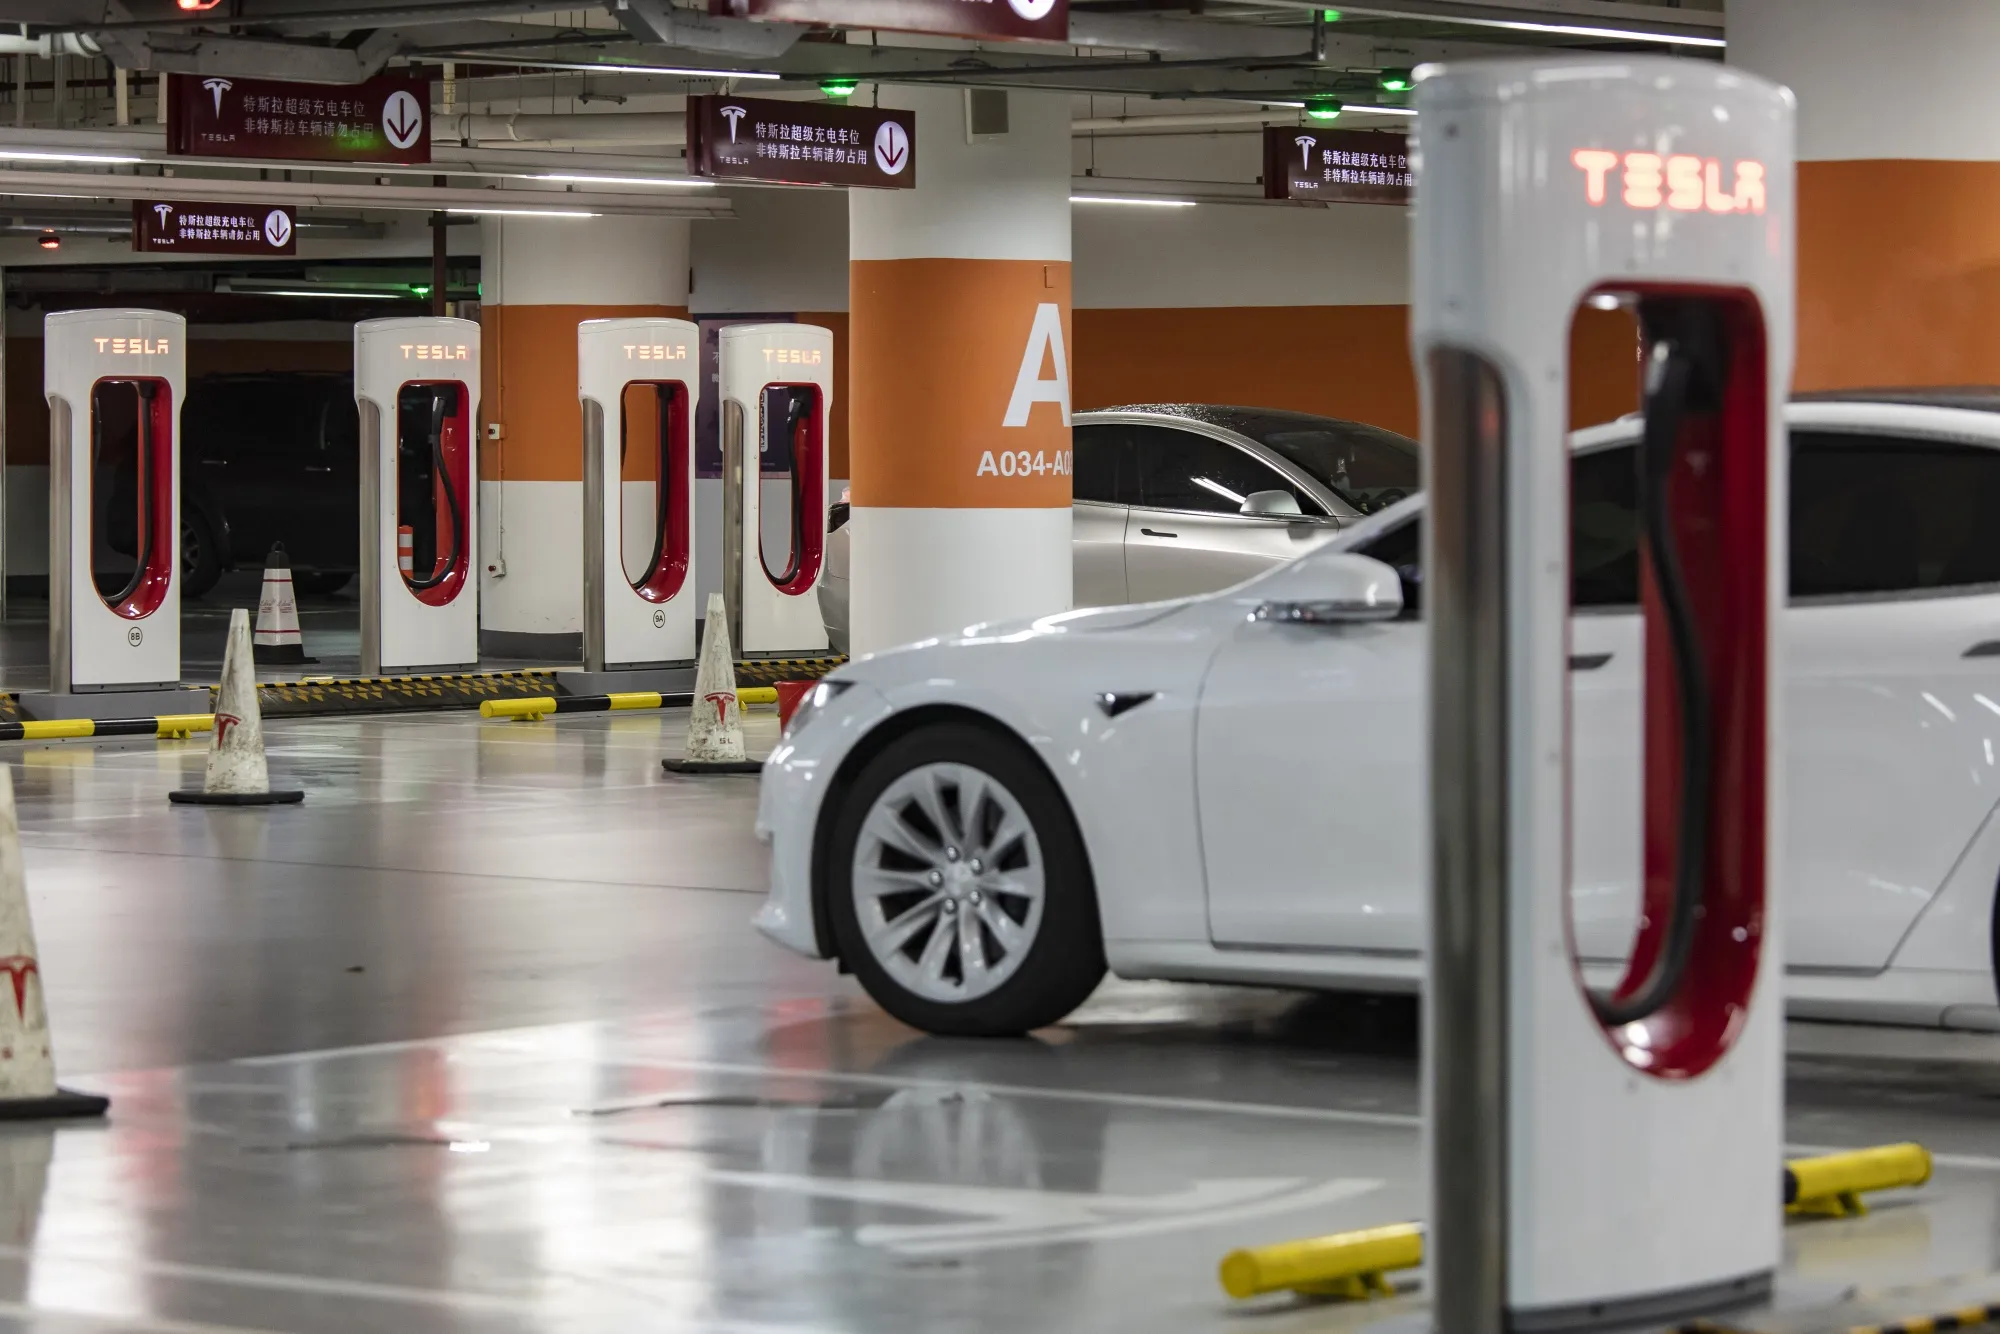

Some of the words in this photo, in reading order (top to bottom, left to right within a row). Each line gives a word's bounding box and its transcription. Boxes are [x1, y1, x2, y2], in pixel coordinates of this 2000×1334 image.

[243, 95, 366, 118] 特斯拉超级充电车位
[243, 117, 374, 139] 非特斯拉车辆请勿占用
[755, 121, 860, 146] 特斯拉超级充电车位
[201, 132, 236, 142] TESLA
[719, 155, 749, 165] TESLA
[755, 142, 867, 166] 非特斯拉车辆请勿占用
[1322, 150, 1407, 169] 特斯拉超级充电车位
[1294, 180, 1319, 189] TESLA
[1323, 168, 1412, 187] 非特斯拉车辆请勿占用
[1572, 149, 1764, 214] TESLA
[178, 214, 255, 228] 特斯拉超级充电车位
[152, 237, 175, 245] TESLA
[178, 228, 260, 241] 非特斯拉车辆请勿占用
[94, 338, 169, 354] TESLA
[399, 344, 467, 360] TESLA
[623, 344, 686, 360] TESLA
[762, 349, 822, 364] TESLA
[1003, 303, 1072, 427] A
